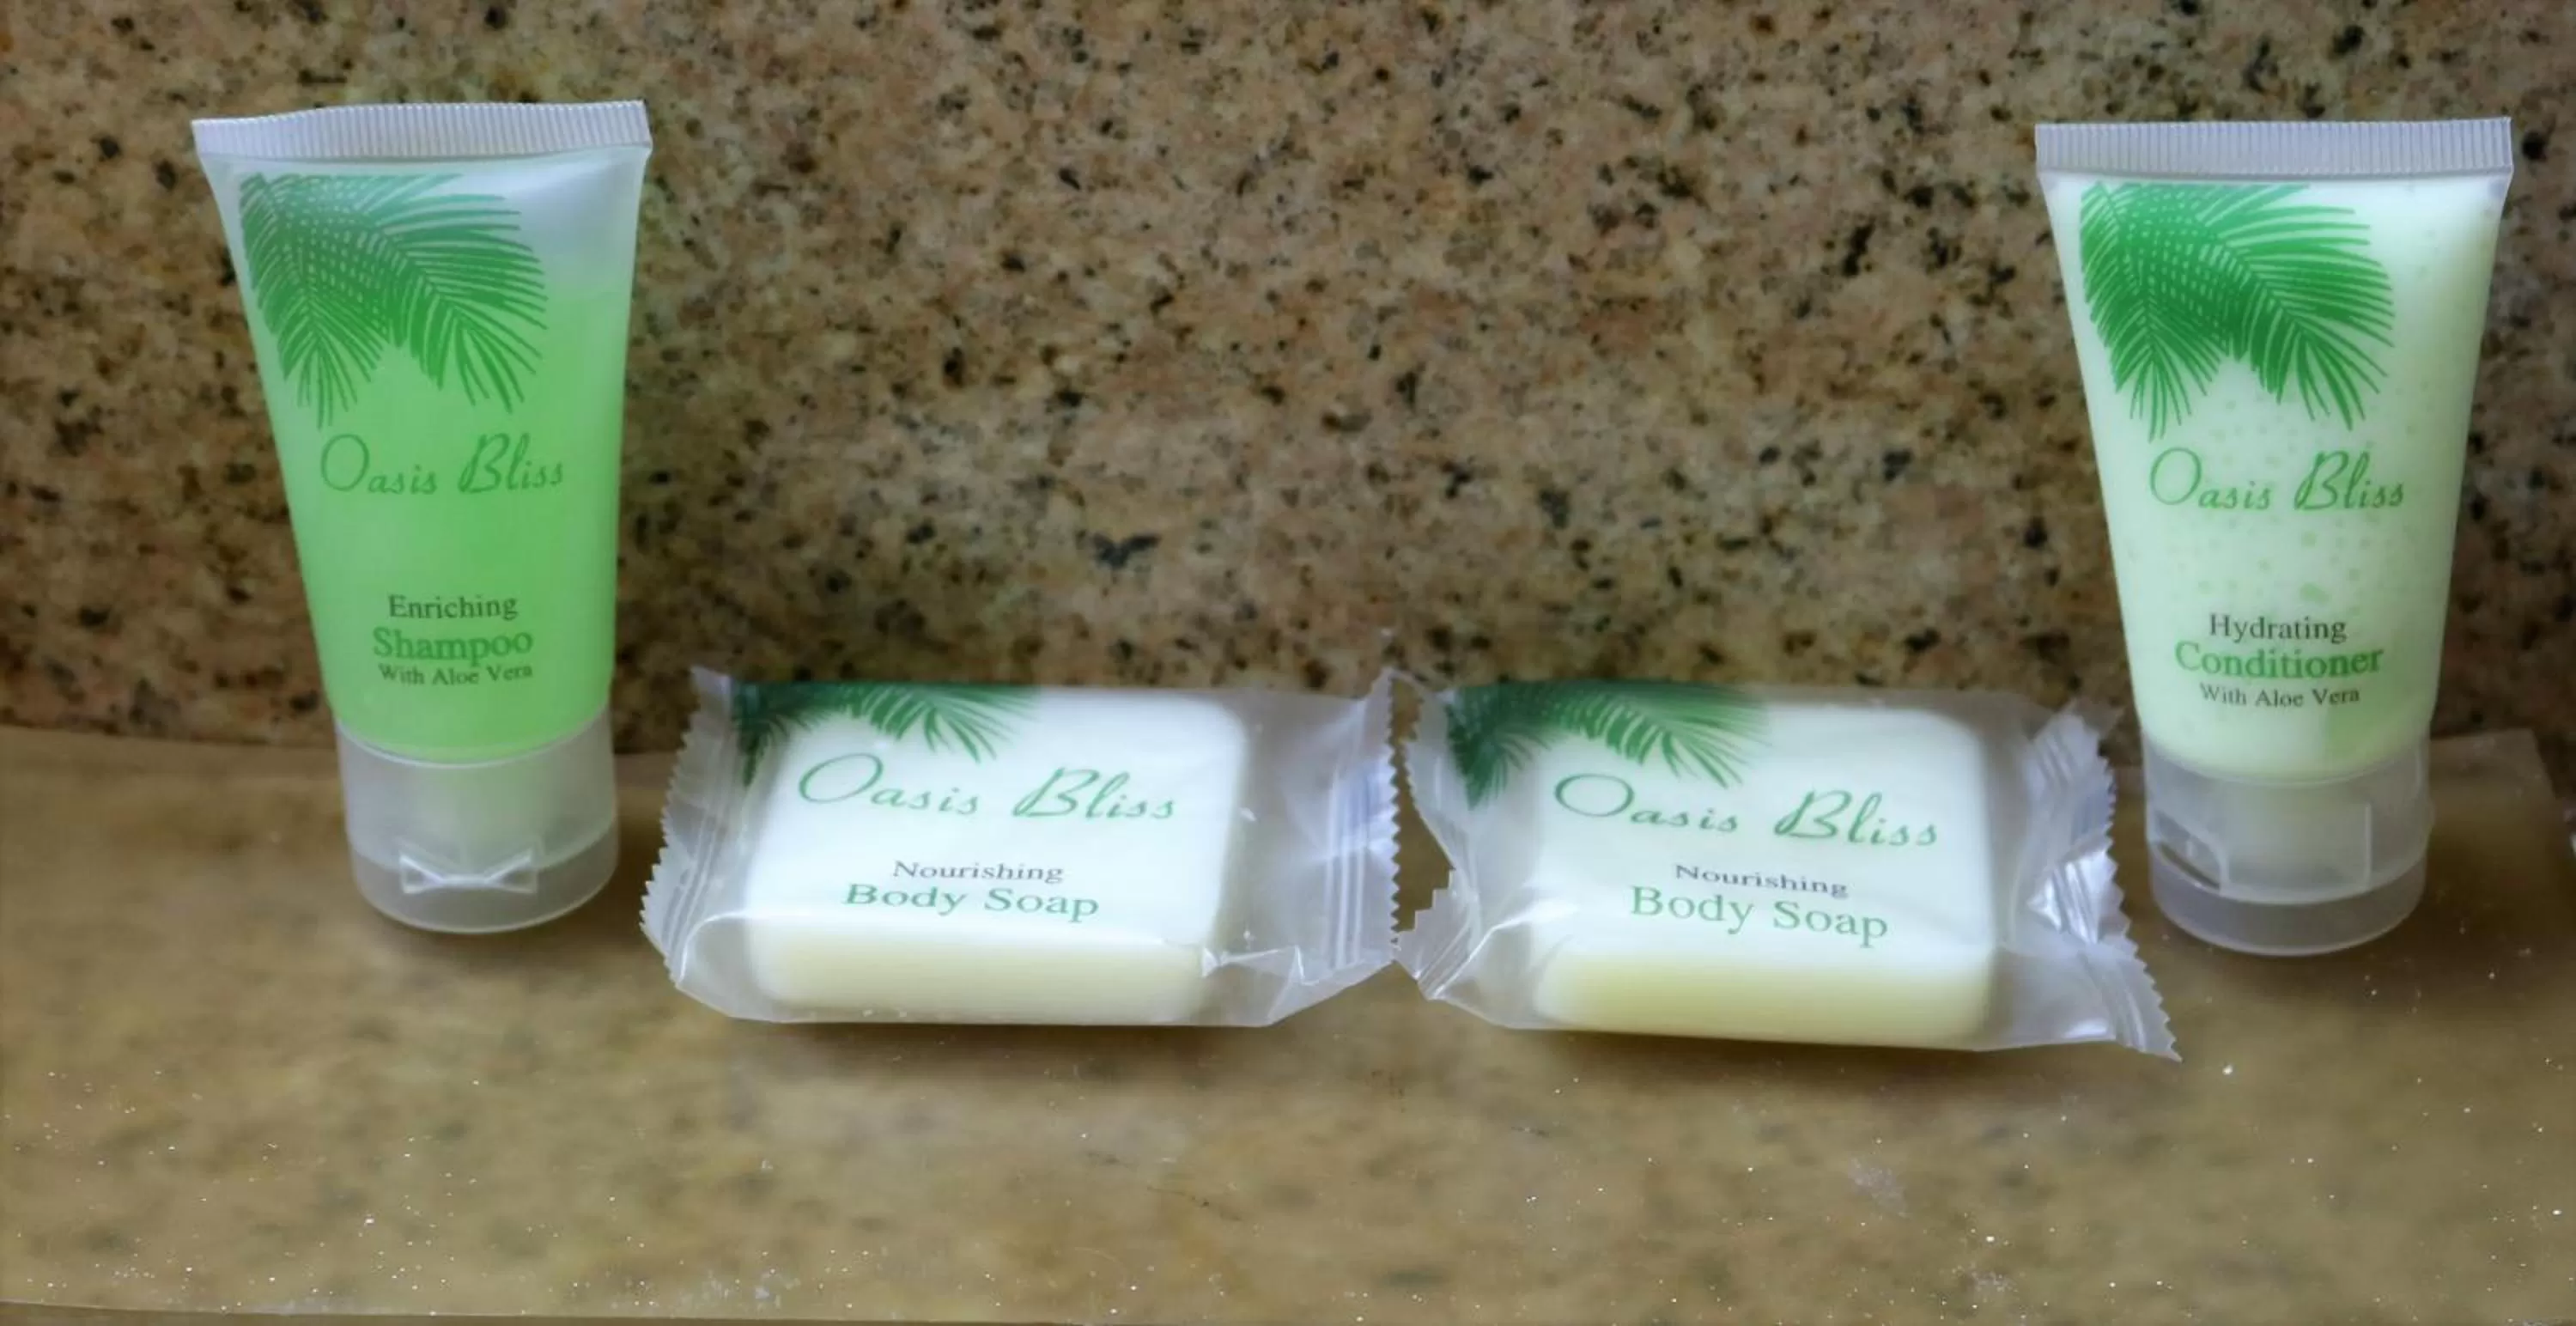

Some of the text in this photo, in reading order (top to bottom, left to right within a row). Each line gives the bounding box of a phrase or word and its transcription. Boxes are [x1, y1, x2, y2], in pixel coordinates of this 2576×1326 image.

[320, 432, 563, 495] Oasis Bliss
[2149, 447, 2403, 511] Oasis Bliss
[388, 593, 519, 621] Enriching
[373, 626, 534, 666] Shampoo
[2209, 612, 2348, 644] Hydrating
[378, 663, 533, 685] With Aloe Vera
[2175, 640, 2384, 678] Conditioner
[2200, 682, 2360, 708] With Aloe Vera
[798, 751, 1176, 819] Oasis Bliss
[1553, 773, 1938, 846] Oasis Bliss
[892, 861, 1065, 884] Nourishing
[1675, 863, 1850, 898] Nourishing
[844, 883, 1099, 923] Body Soap
[1631, 885, 1889, 948] Body Soap
